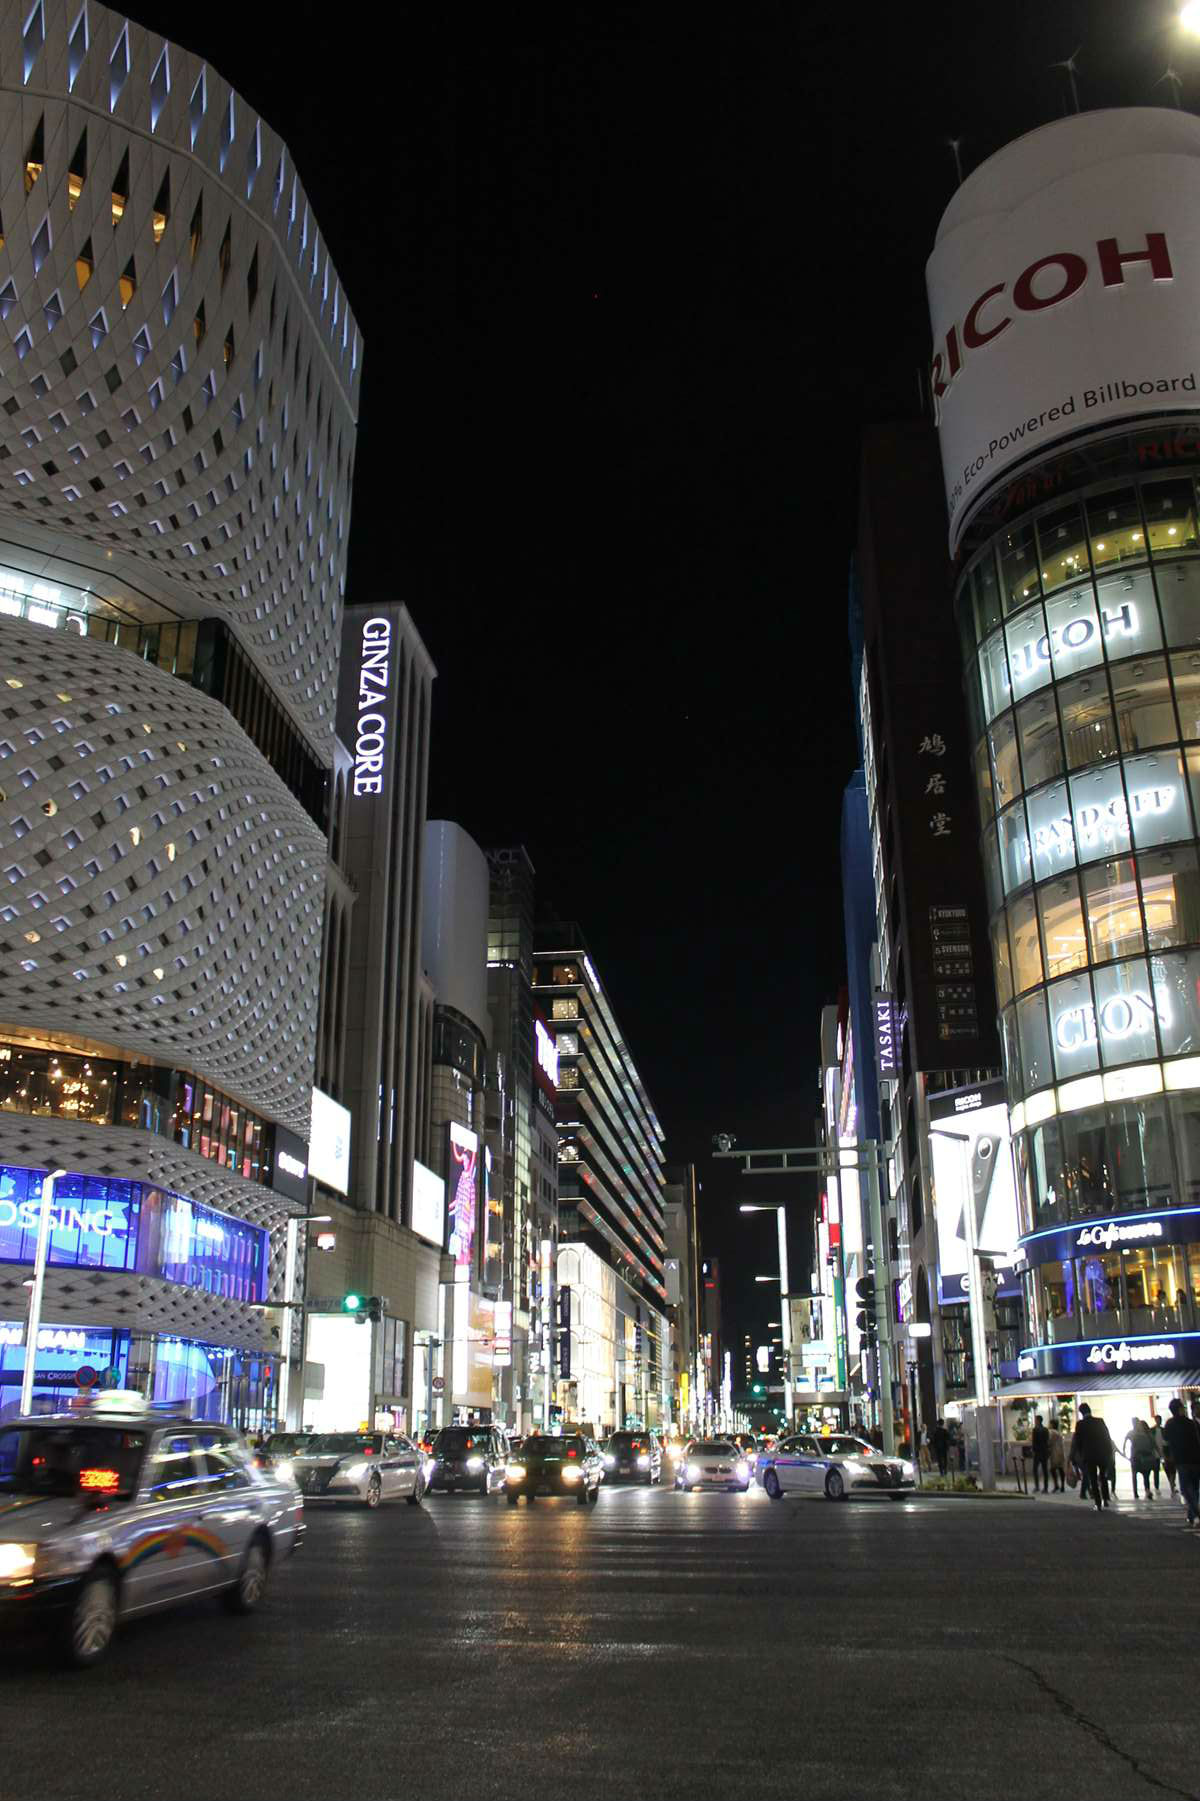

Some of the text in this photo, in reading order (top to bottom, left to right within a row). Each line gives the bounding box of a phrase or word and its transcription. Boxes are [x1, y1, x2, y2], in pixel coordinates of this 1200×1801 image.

[932, 232, 1174, 398] RICOH
[963, 396, 1076, 485] Eco-Powered
[1083, 374, 1196, 408] Billboard
[1002, 604, 1133, 688] RICOH
[353, 617, 391, 796] GINZA CORE
[877, 1001, 894, 1071] TASAKI
